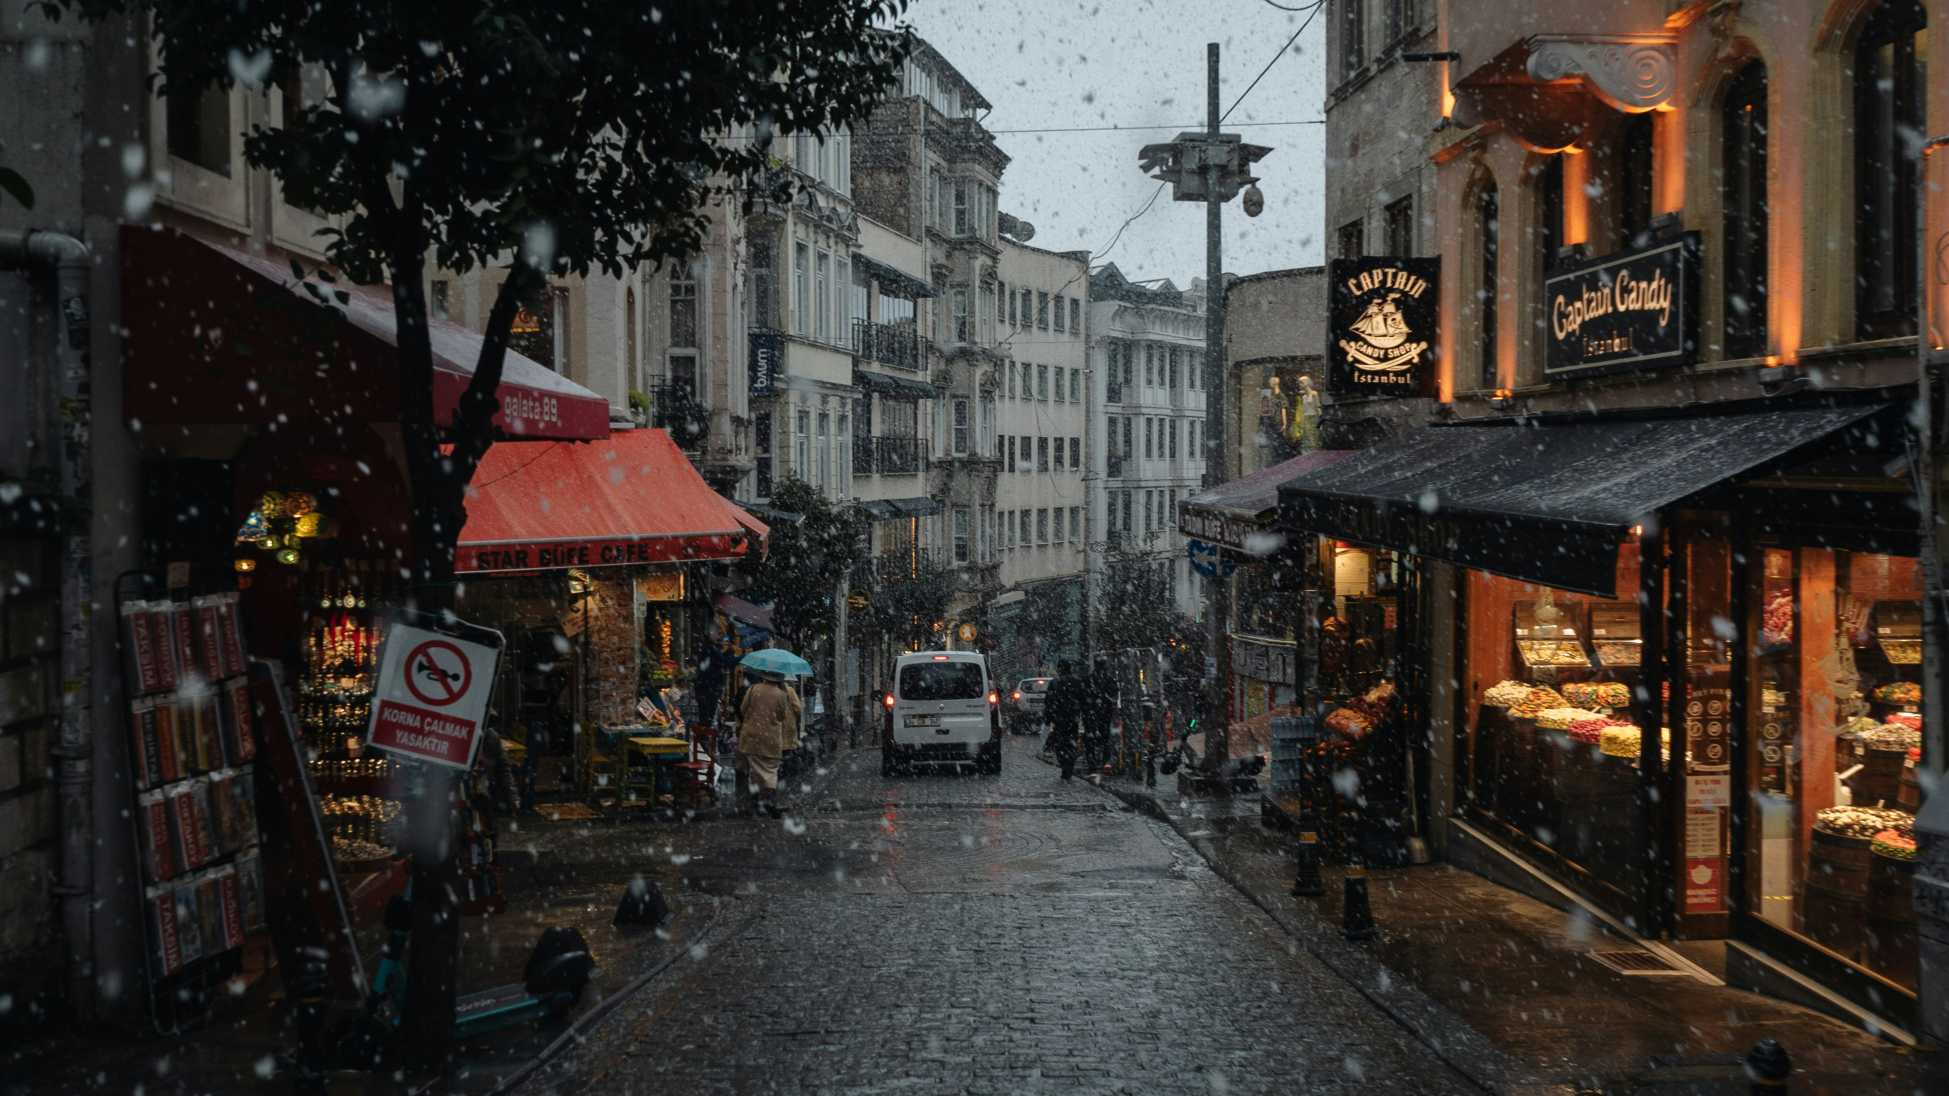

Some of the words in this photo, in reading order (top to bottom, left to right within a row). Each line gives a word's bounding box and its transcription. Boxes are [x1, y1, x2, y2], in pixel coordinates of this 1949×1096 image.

[1347, 267, 1427, 298] CAPTAIN
[1553, 283, 1614, 341] Captain
[1616, 269, 1672, 327] Candy
[1356, 341, 1385, 358] CANDY
[1387, 343, 1411, 358] SHOP
[504, 391, 541, 423] galata
[543, 396, 559, 422] 89
[478, 550, 529, 570] STAR
[382, 706, 421, 728] KORNA
[423, 717, 470, 740] ÇALMAK
[395, 728, 449, 755] YASAKTIR
